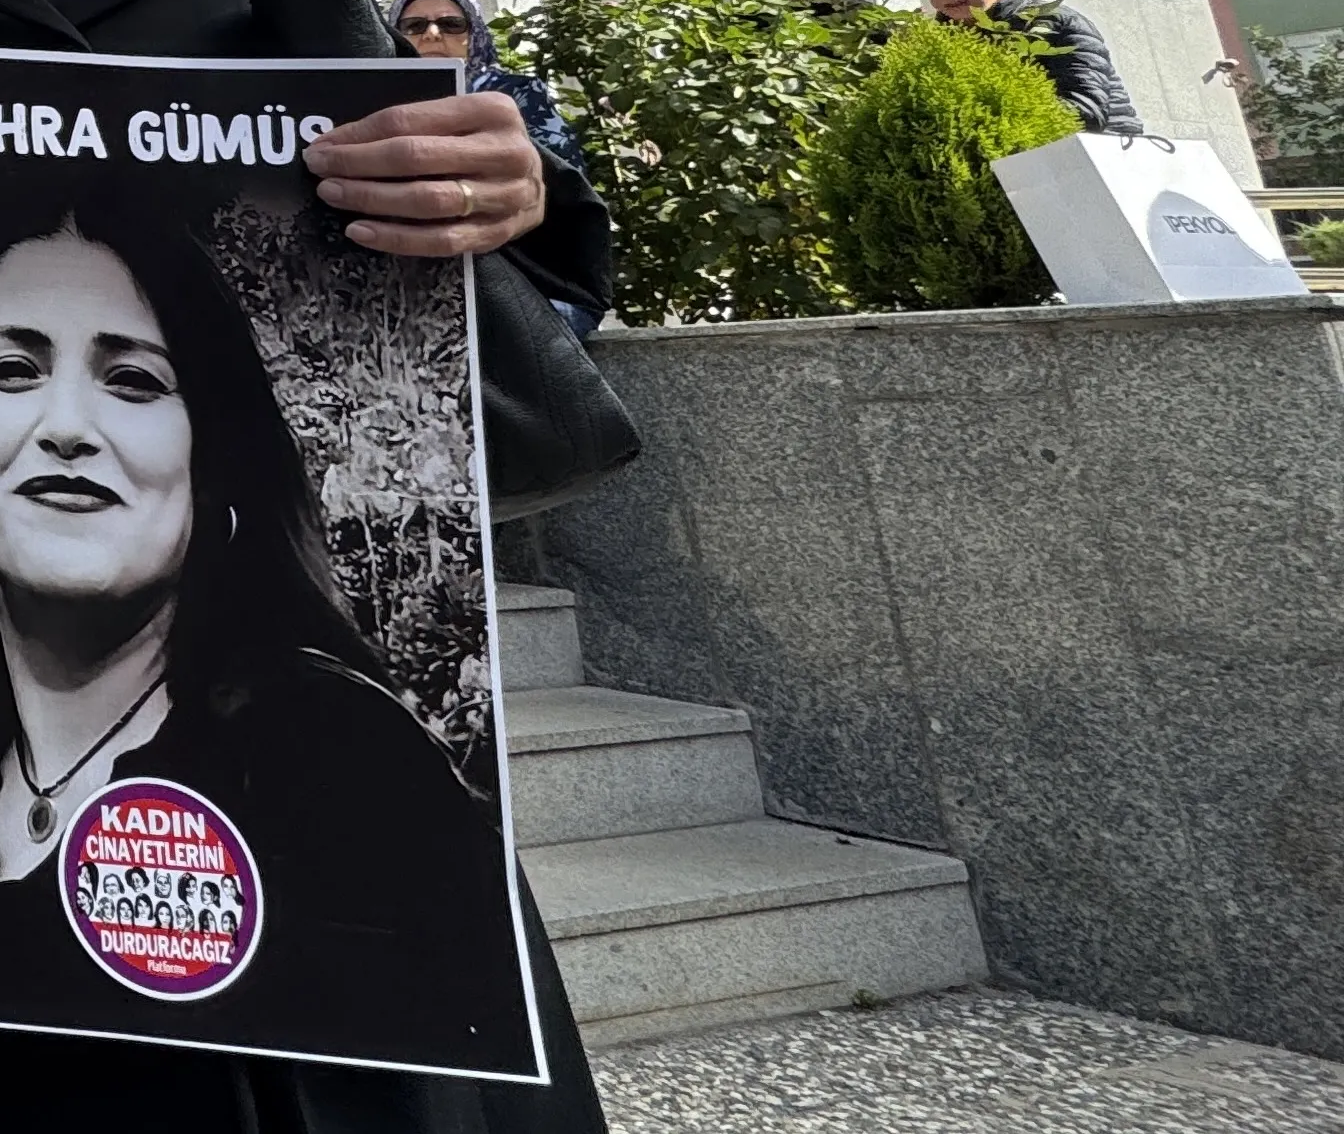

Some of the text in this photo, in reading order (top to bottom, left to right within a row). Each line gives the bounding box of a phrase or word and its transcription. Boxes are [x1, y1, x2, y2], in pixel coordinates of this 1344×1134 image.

[100, 805, 206, 840] KADIN
[86, 831, 225, 871] CİNAYETLERİNİ
[100, 929, 233, 965] DURDURACAĞIZ
